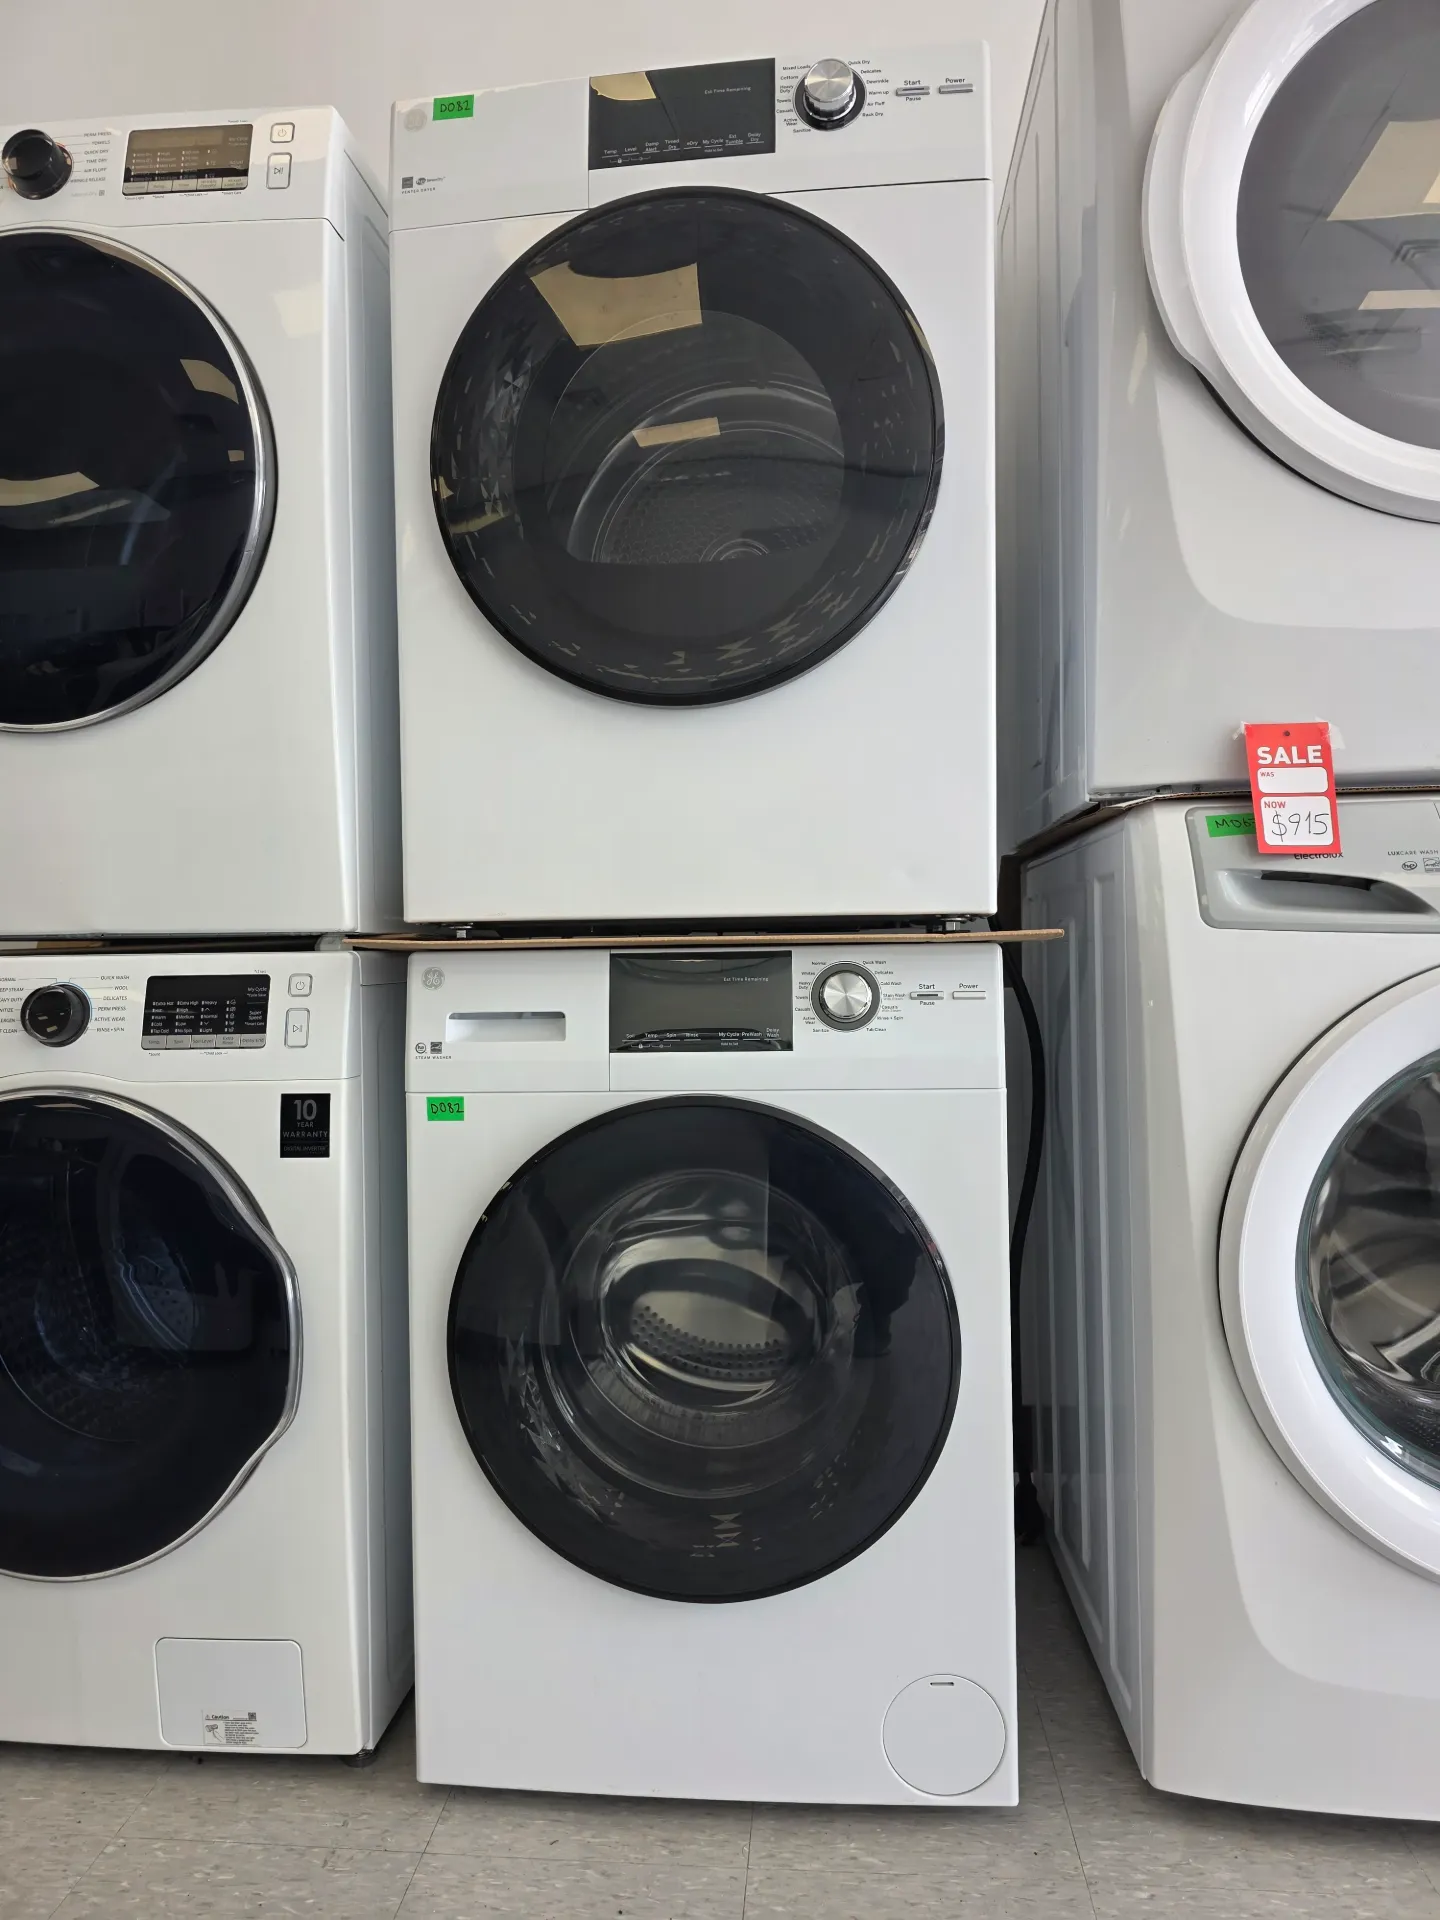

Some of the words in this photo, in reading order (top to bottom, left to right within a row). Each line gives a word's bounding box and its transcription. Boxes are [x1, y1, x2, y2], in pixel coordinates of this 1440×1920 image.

[1257, 745, 1323, 765] SALE
[1264, 801, 1286, 809] NOW
[1272, 810, 1329, 842] $915
[293, 1099, 317, 1121] 10
[282, 1130, 328, 1138] WARRANTY
